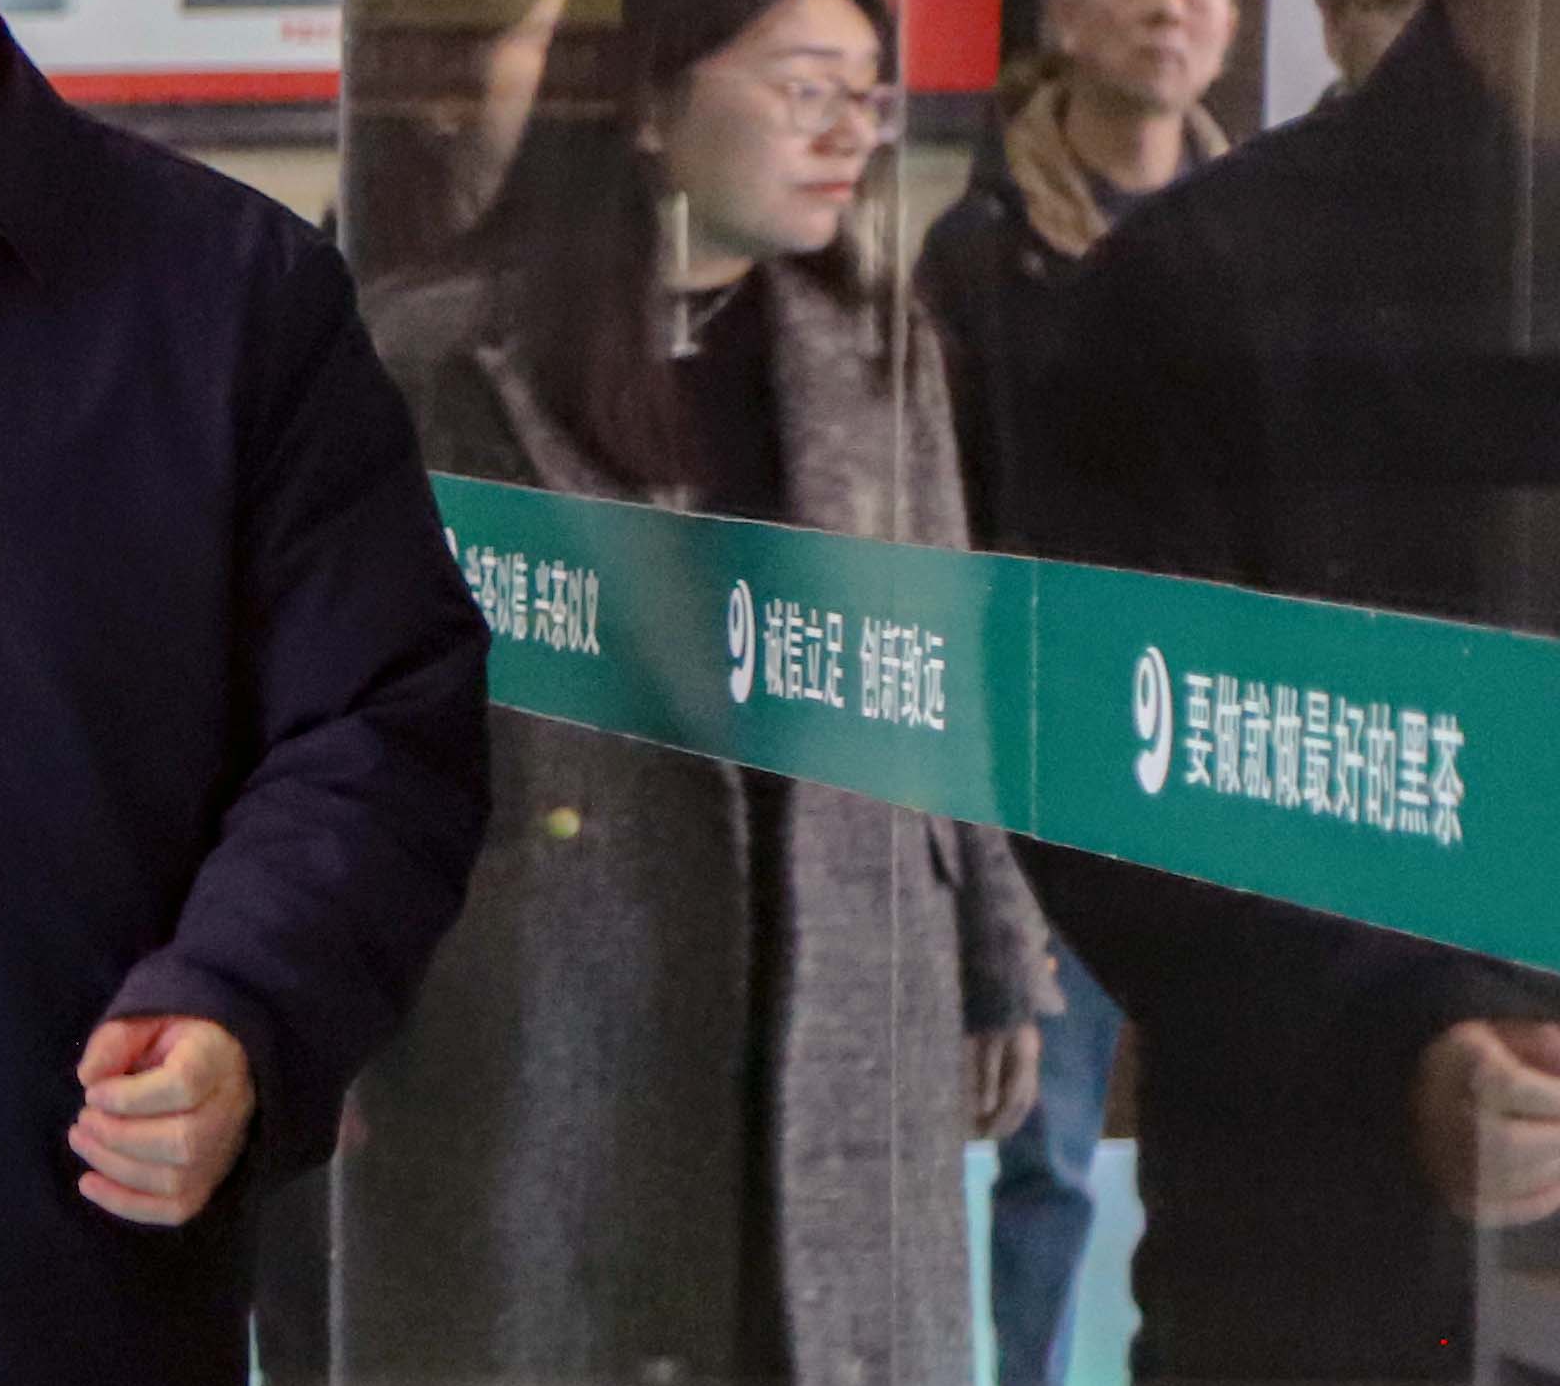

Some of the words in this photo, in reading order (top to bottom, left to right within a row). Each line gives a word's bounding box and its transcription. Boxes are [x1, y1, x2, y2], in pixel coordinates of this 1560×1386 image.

[763, 597, 846, 709] 诚信立足
[858, 615, 946, 732] 创新致远
[1184, 672, 1466, 847] 要做就做最好的黑茶
